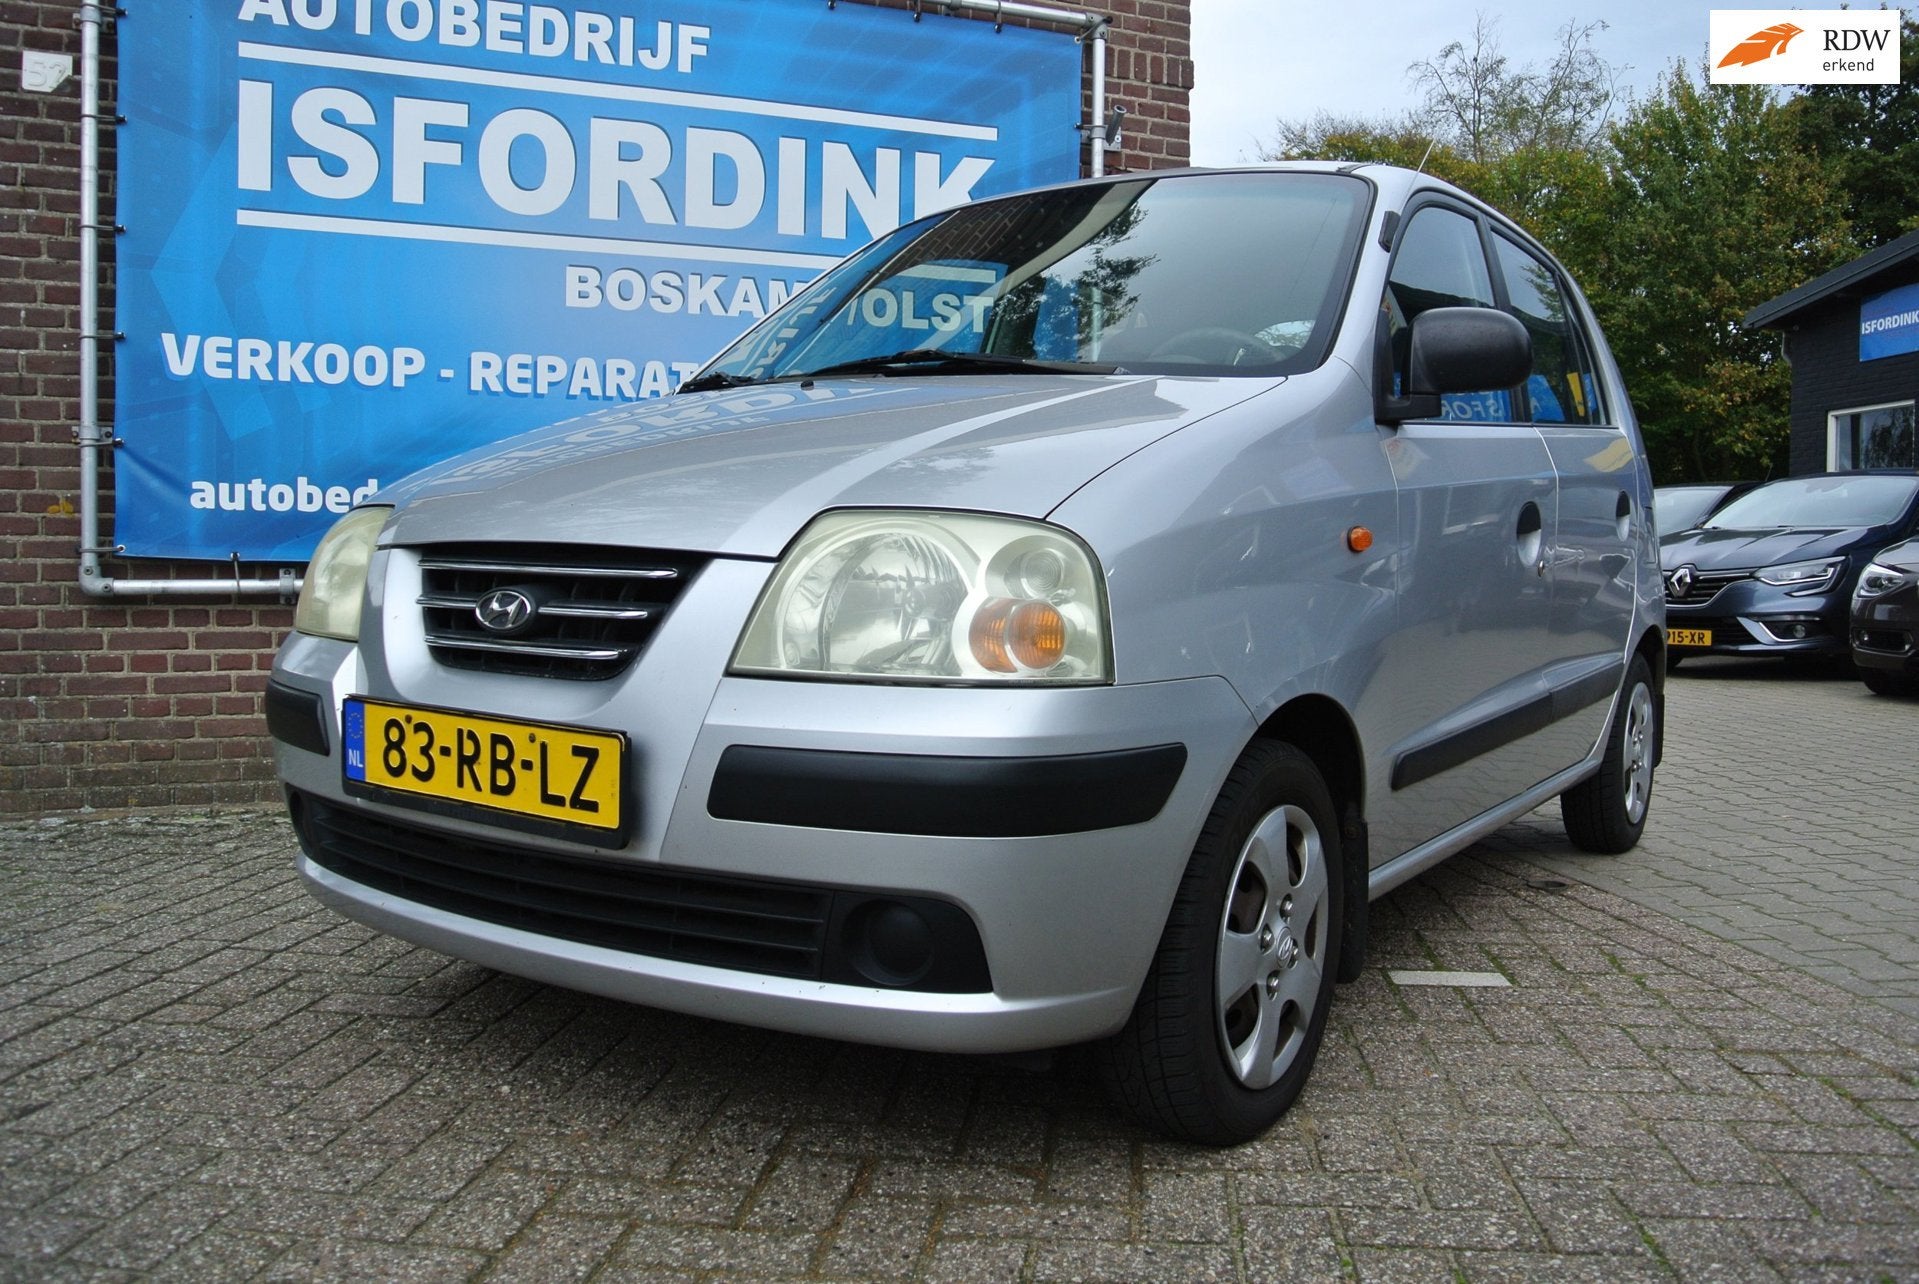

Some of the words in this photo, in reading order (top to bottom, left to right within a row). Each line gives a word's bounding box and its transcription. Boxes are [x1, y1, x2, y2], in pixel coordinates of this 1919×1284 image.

[238, 0, 711, 74] AUTOBEDRIJF
[236, 78, 997, 240] ISFORDINK
[1861, 310, 1919, 335] ISFORDINK
[161, 332, 426, 388] VERKOOP
[190, 476, 378, 514] autobed
[348, 748, 364, 768] NL
[382, 717, 600, 814] 83-RB-LZ
